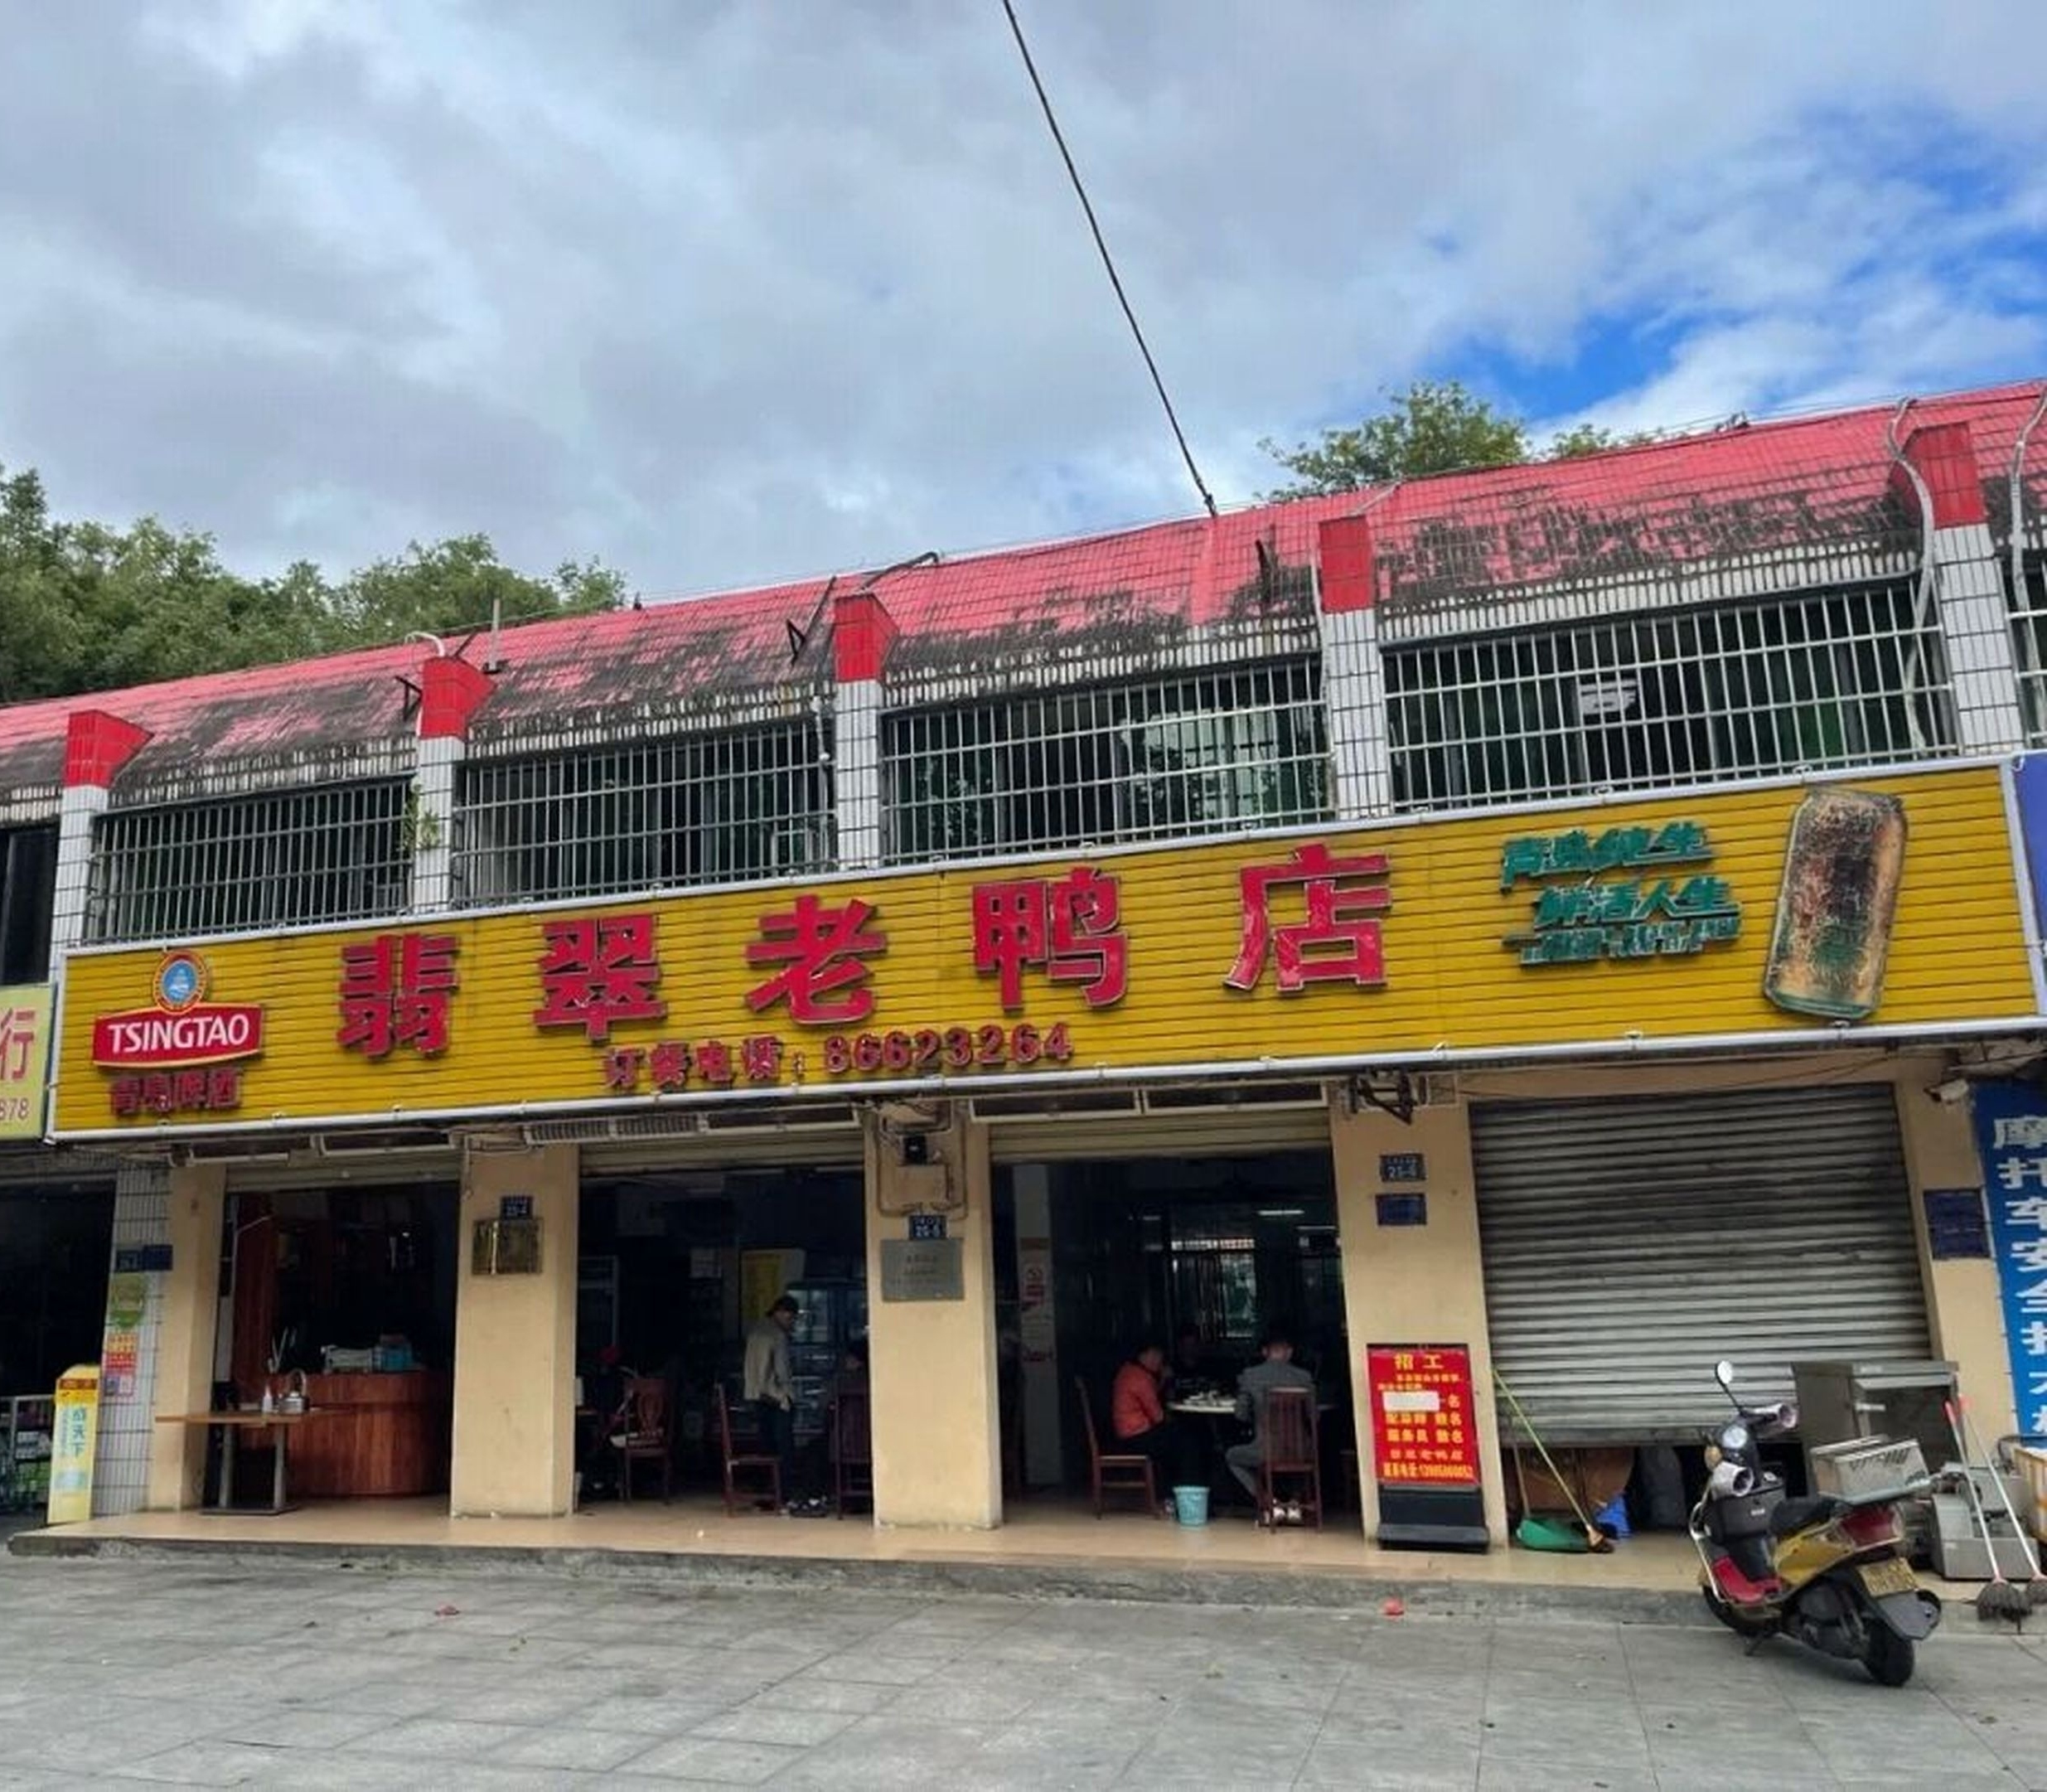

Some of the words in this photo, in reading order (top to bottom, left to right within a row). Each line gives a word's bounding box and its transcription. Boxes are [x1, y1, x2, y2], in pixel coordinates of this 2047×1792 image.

[336, 842, 1391, 1060] 翡翠老鸭店
[108, 1014, 249, 1054] TSINGTAO
